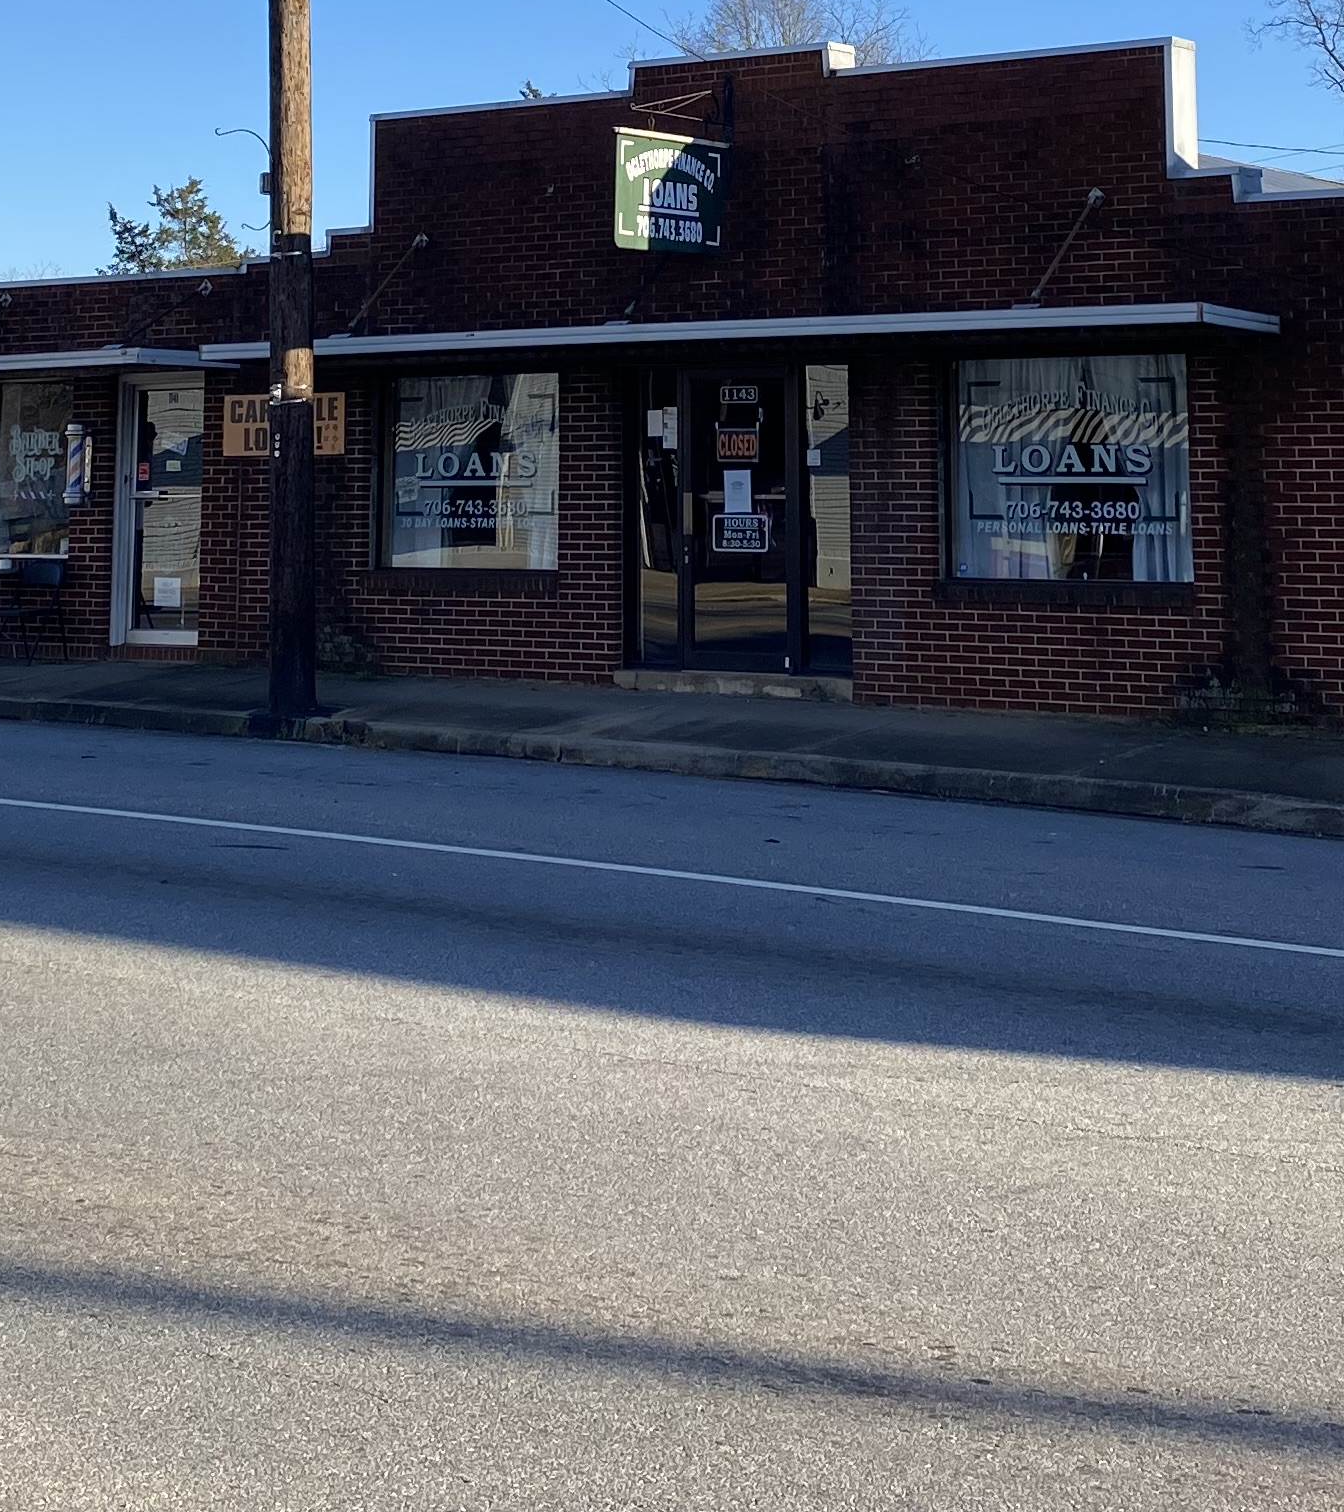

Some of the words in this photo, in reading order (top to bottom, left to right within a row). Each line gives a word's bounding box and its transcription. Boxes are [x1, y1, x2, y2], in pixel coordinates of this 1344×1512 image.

[674, 149, 706, 183] FINANCE
[642, 176, 698, 211] LOANS
[636, 214, 704, 244] 706.743.3680
[723, 388, 756, 401] 1143
[1075, 380, 1137, 417] FINANCE
[718, 434, 757, 457] CLOSED
[415, 452, 538, 478] LOANS
[990, 443, 1154, 475] LOANS
[400, 517, 412, 528] 30
[414, 516, 432, 528] DAY
[1005, 500, 1142, 521] 706-743-3680
[723, 518, 760, 528] HOURS
[975, 520, 1042, 534] PERSONAL
[1045, 521, 1127, 535] LOANS-TITLE
[1130, 522, 1174, 535] LOANS
